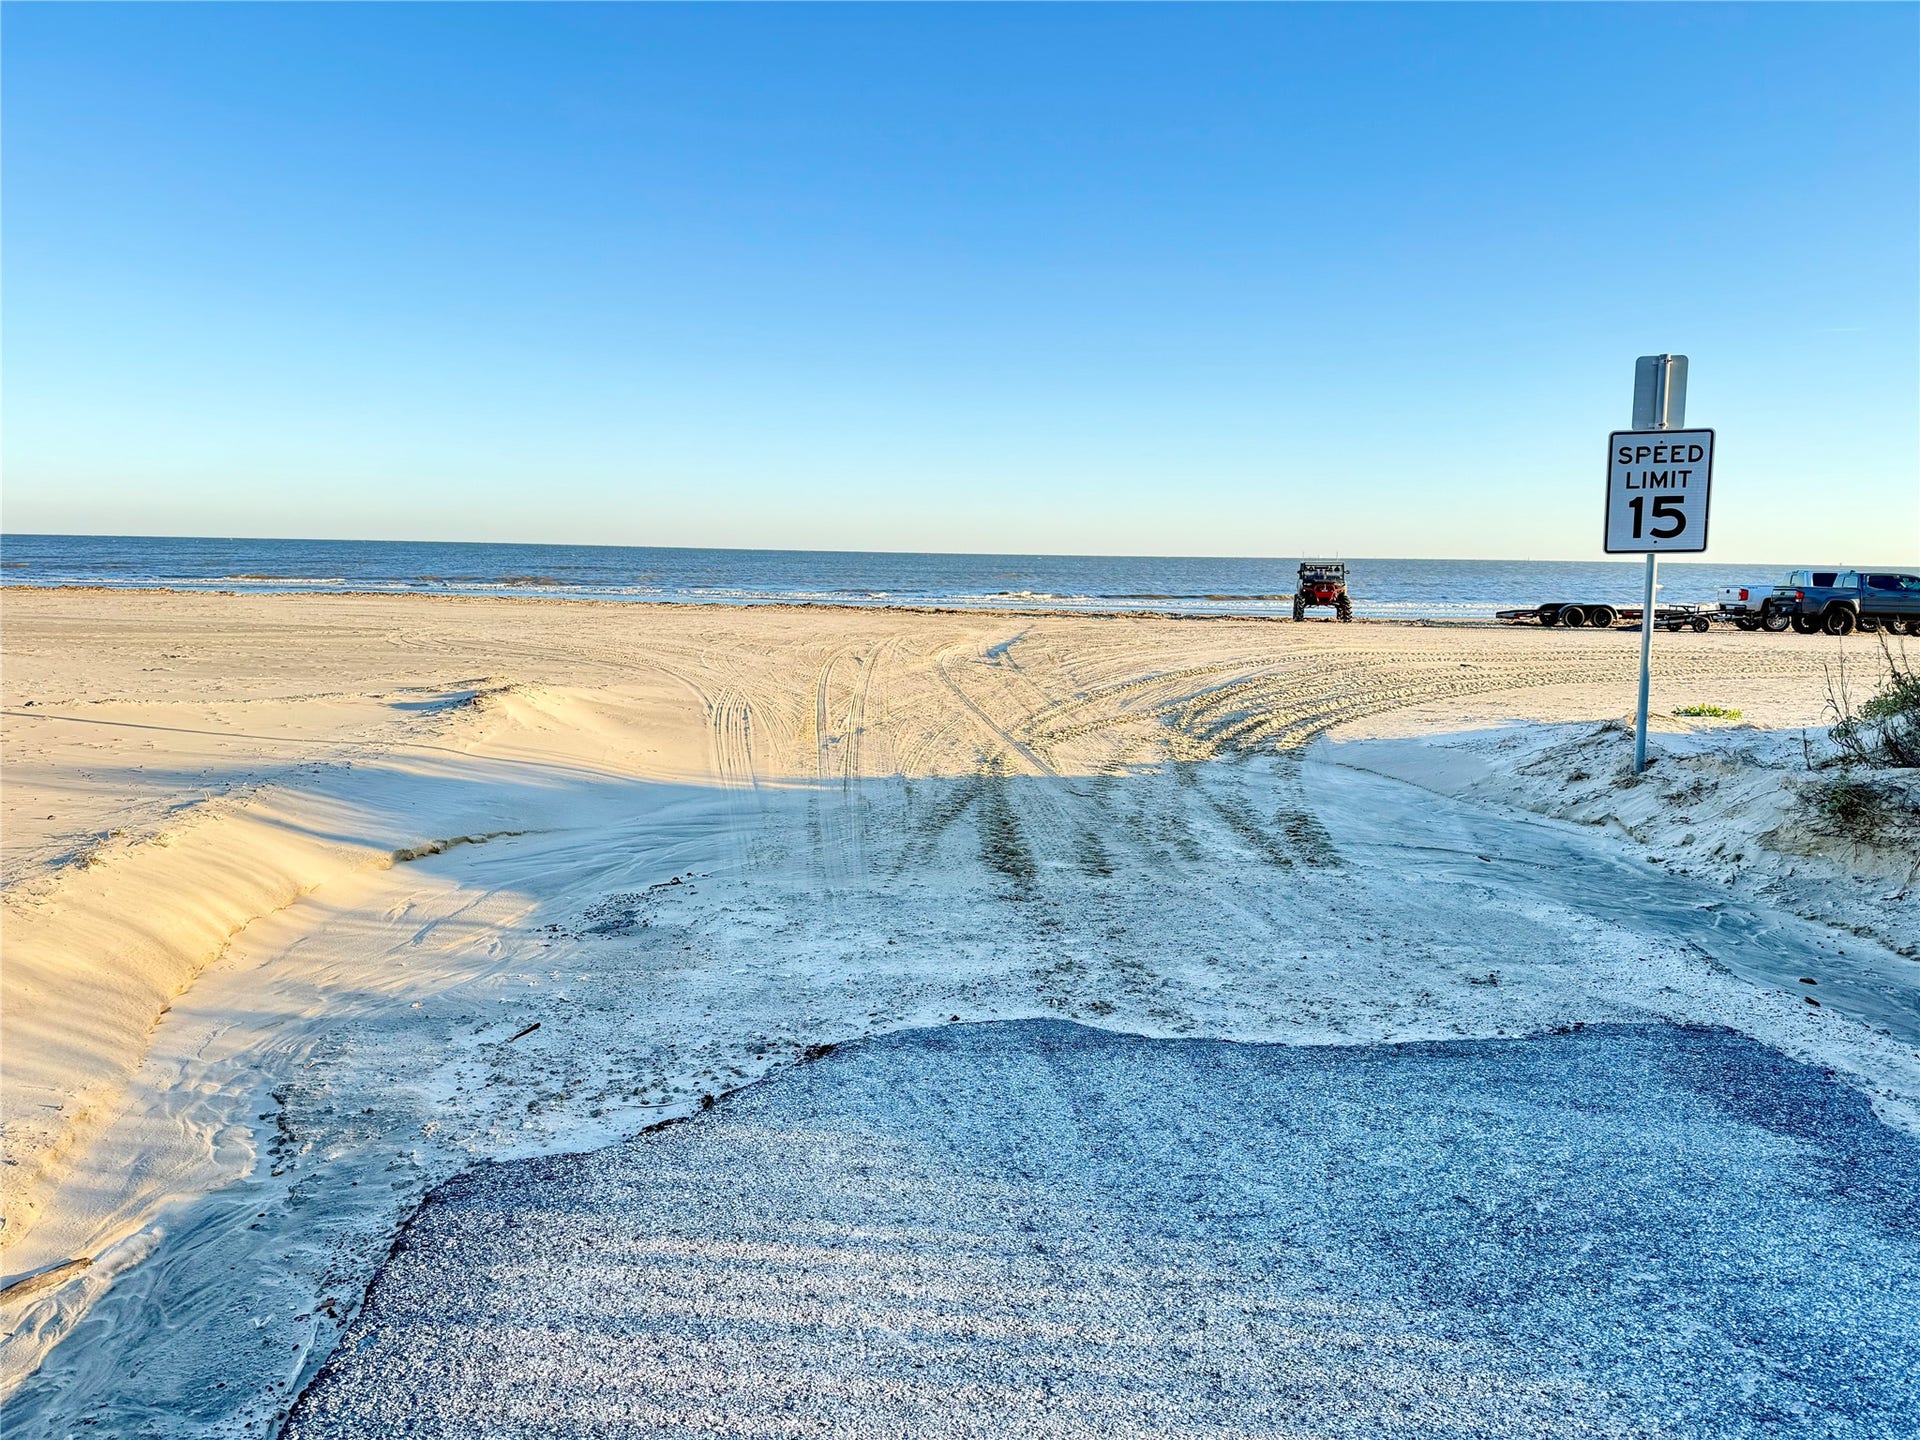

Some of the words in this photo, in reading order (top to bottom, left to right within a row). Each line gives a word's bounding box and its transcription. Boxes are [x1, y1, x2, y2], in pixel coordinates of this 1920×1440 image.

[1618, 445, 1704, 464] SPEED
[1626, 470, 1692, 489] LIMIT
[1629, 496, 1686, 538] 15
